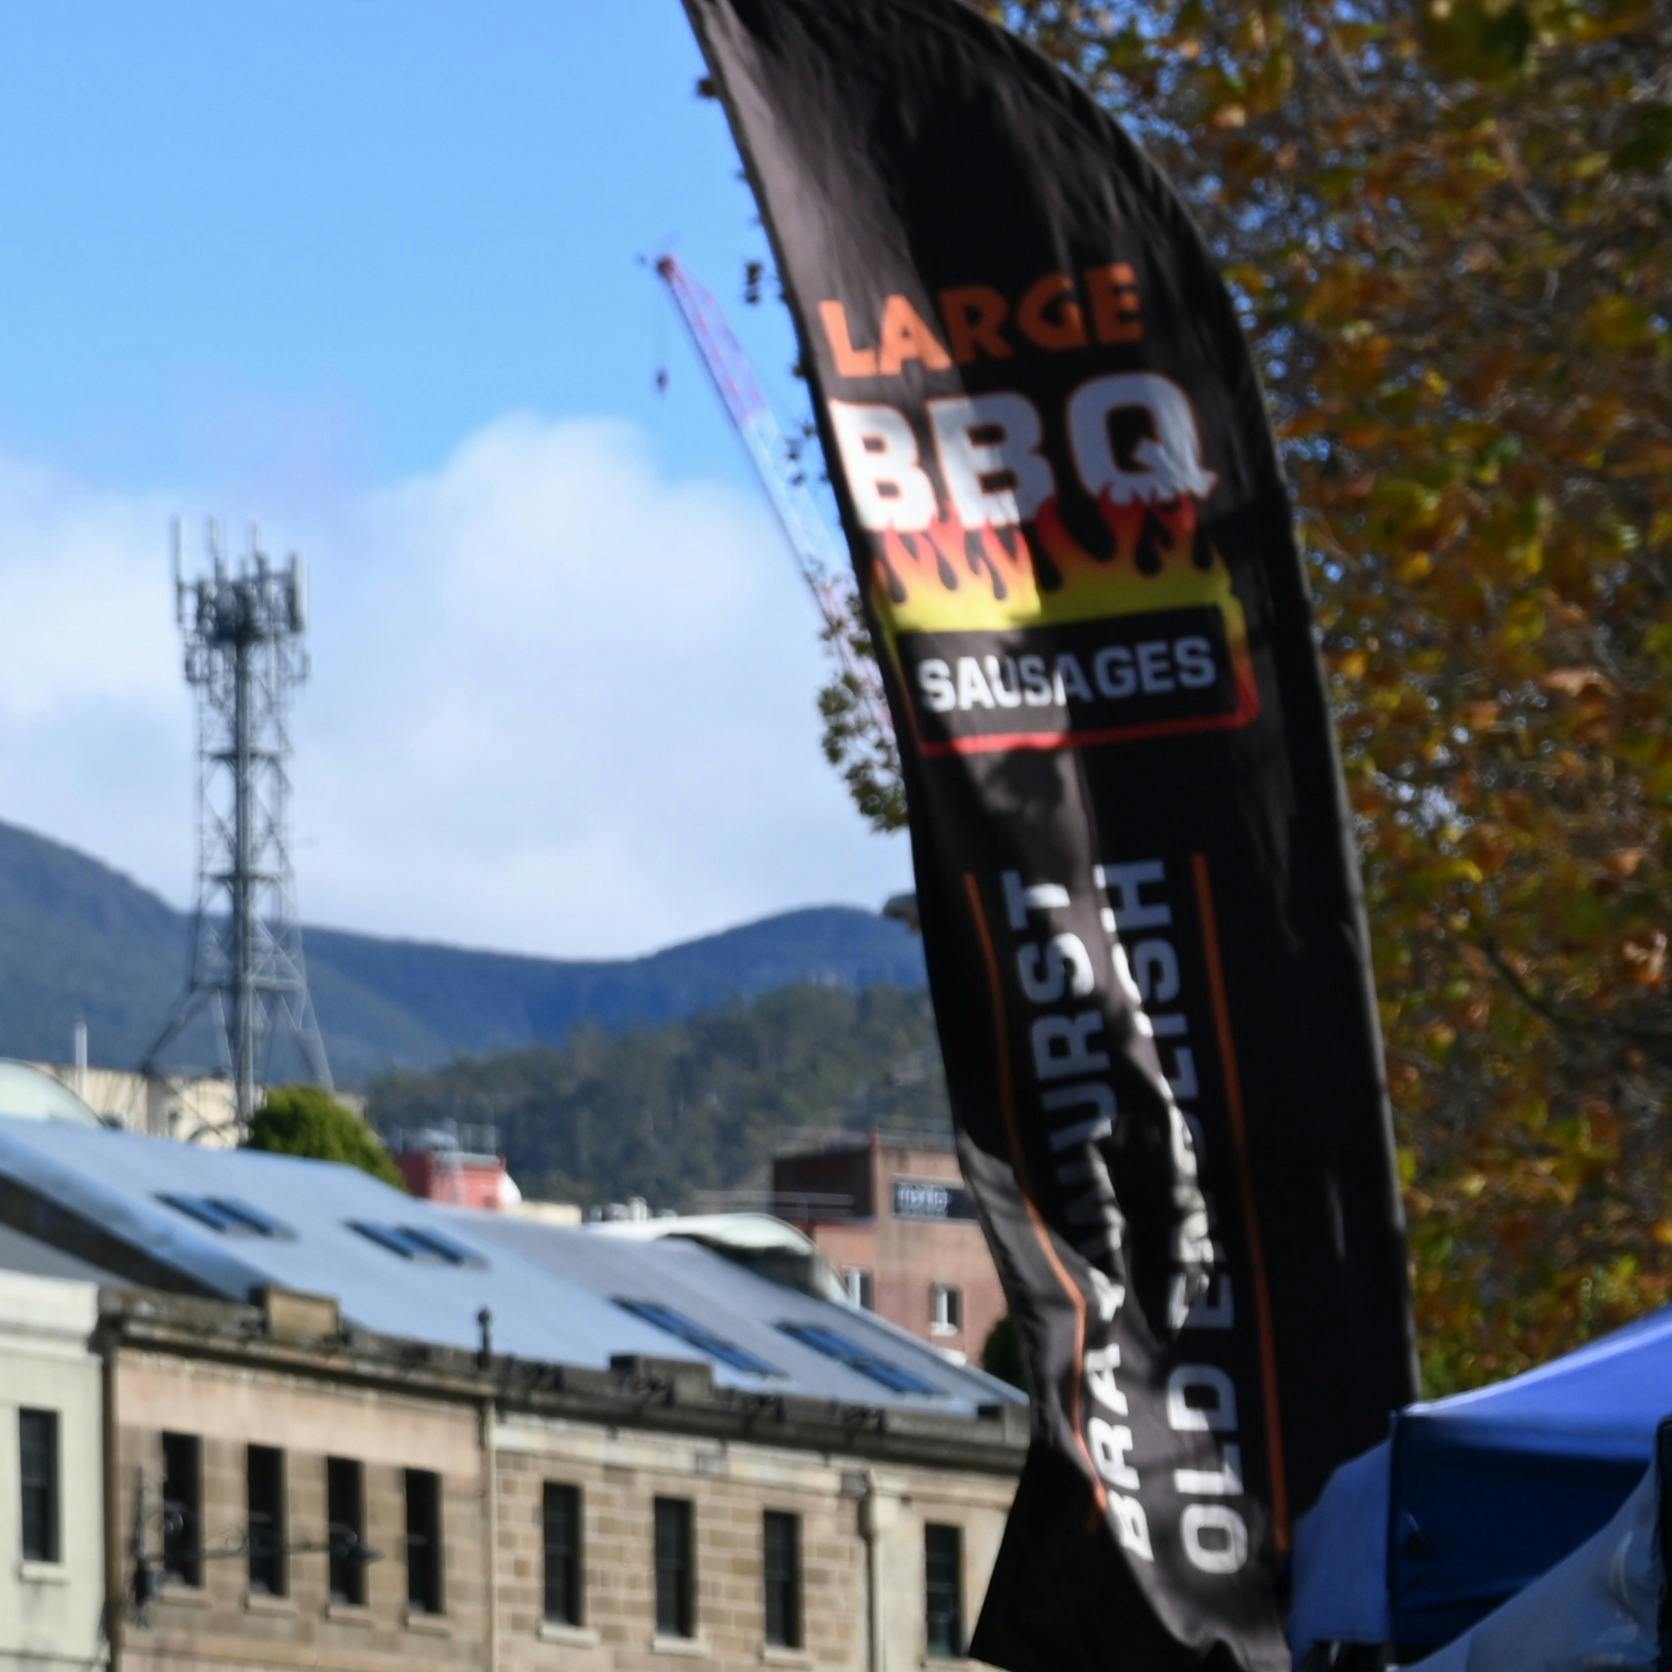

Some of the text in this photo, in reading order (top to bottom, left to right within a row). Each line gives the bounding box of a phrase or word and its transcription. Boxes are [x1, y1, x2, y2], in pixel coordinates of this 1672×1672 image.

[818, 262, 1145, 378] LARGE
[829, 372, 1218, 532] BBQ
[918, 636, 1218, 712] SAUSAGES
[1165, 1362, 1249, 1576] OLD
